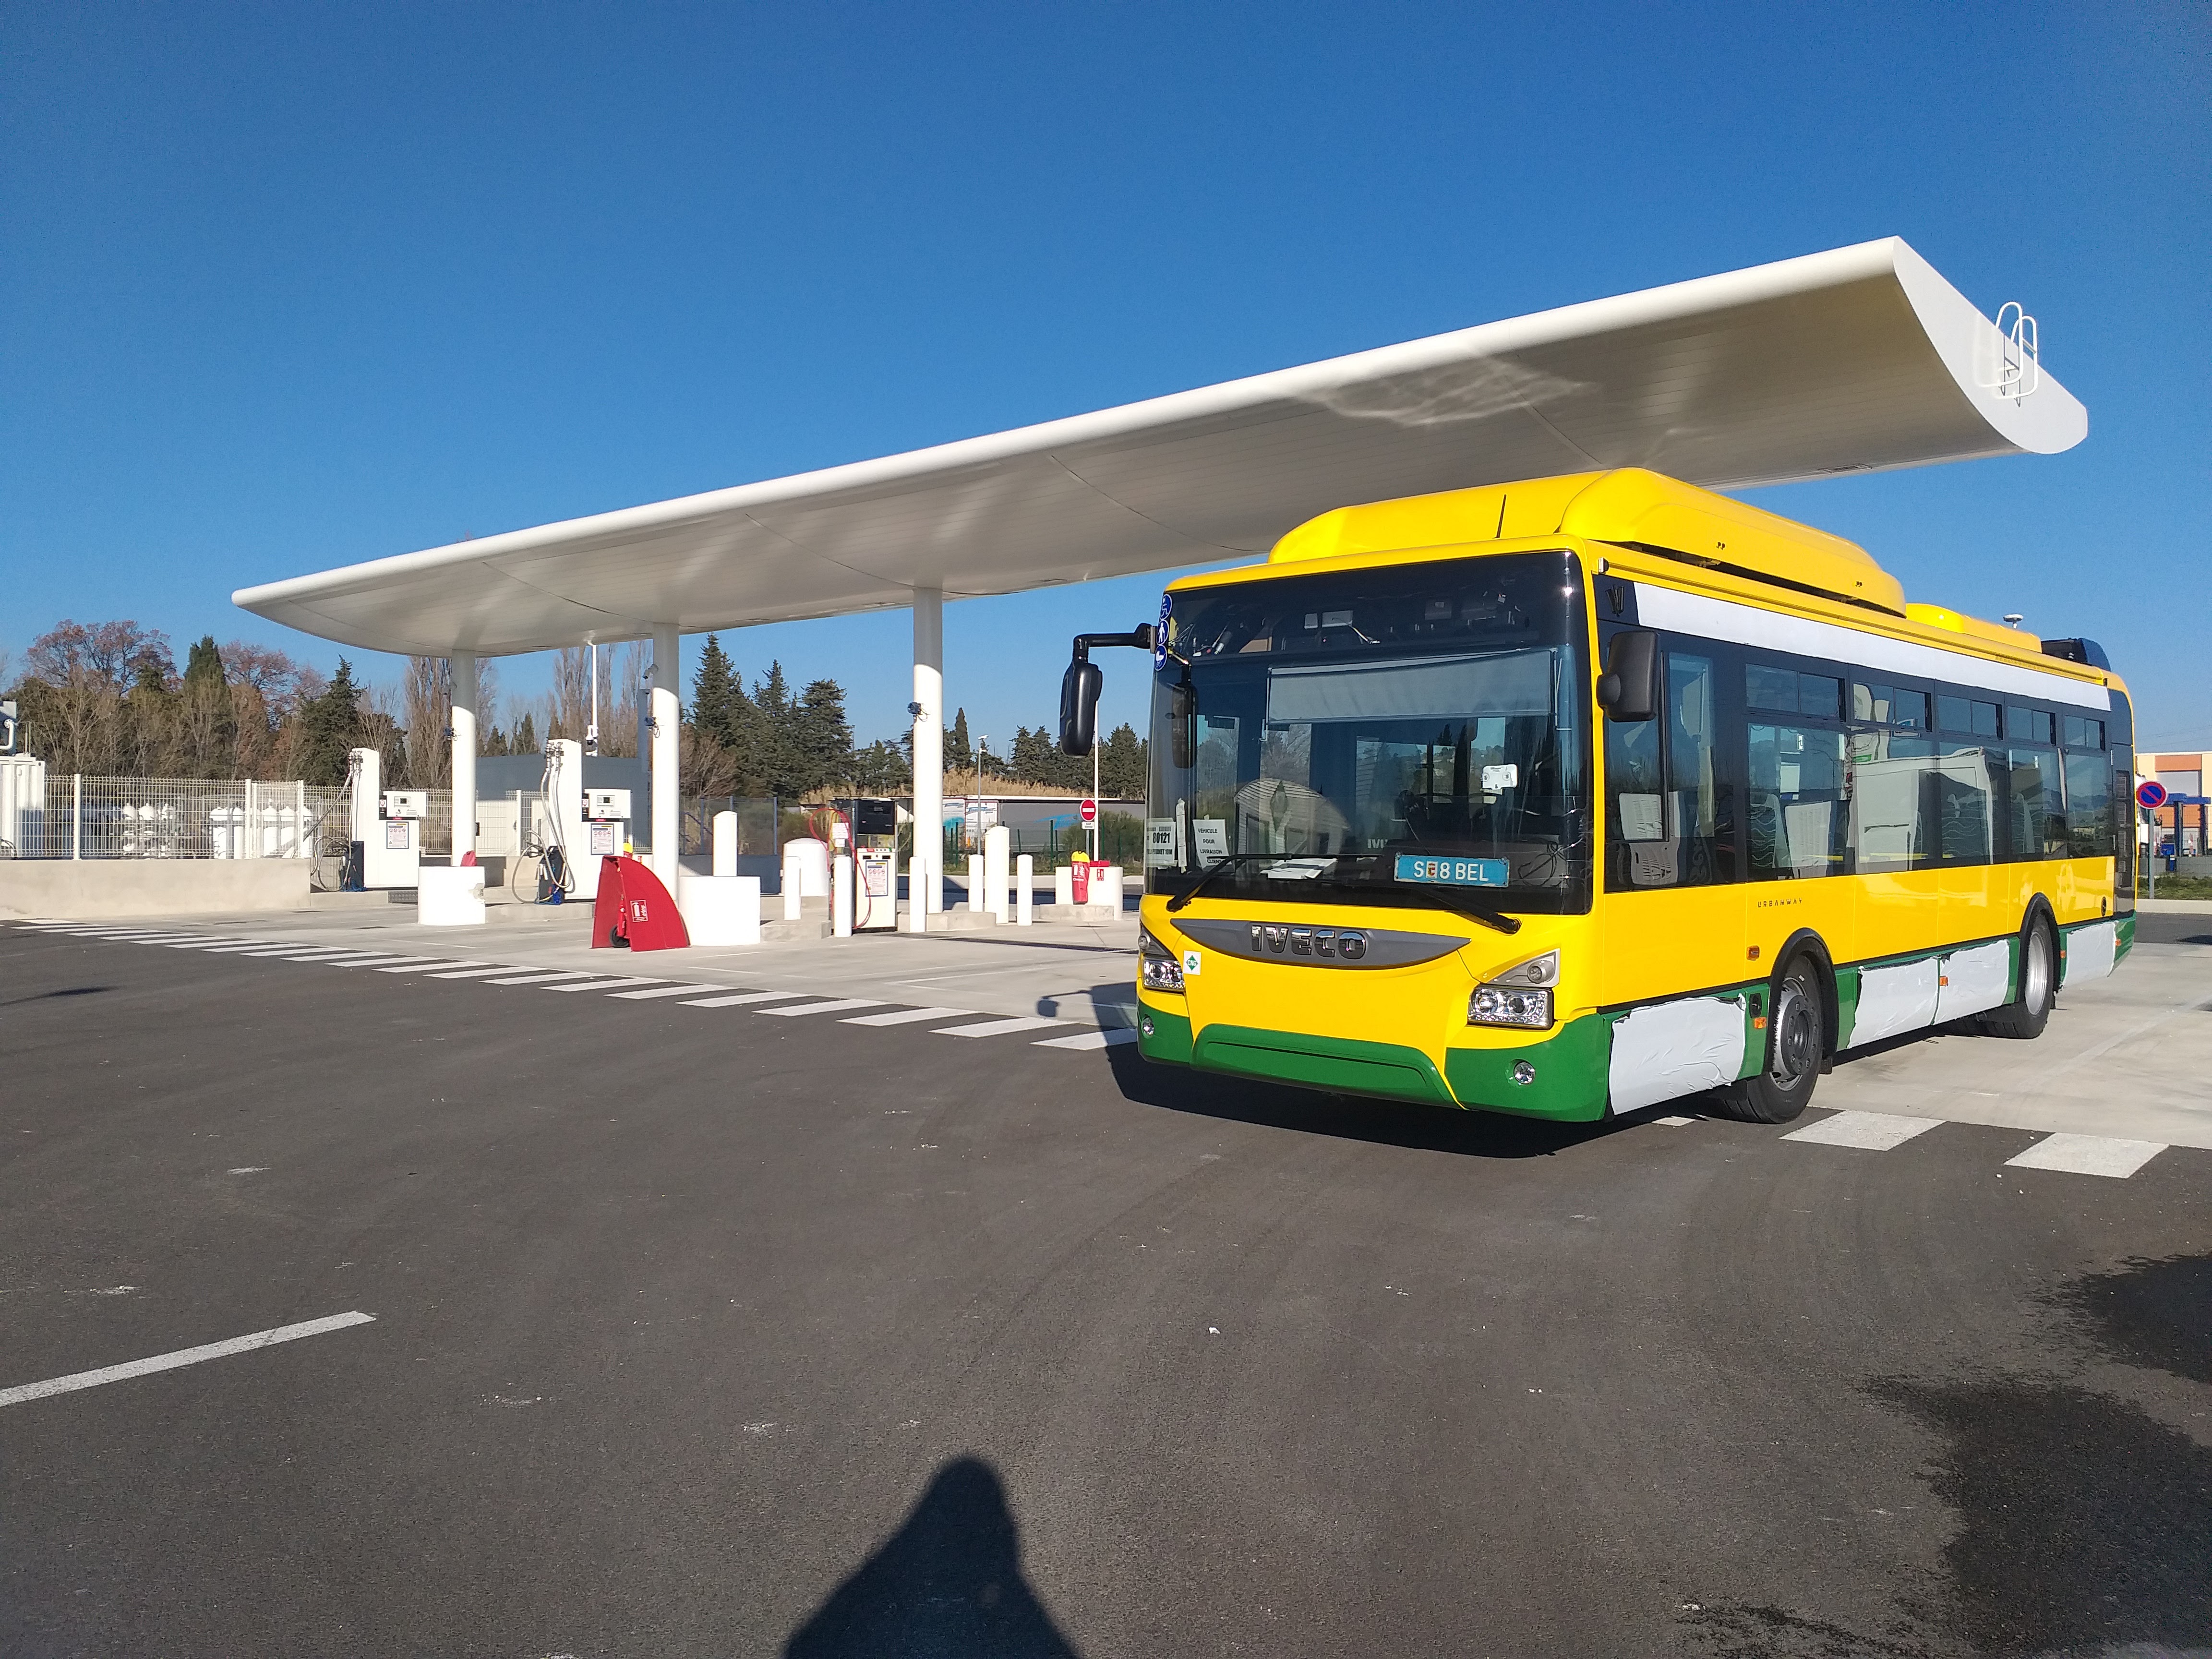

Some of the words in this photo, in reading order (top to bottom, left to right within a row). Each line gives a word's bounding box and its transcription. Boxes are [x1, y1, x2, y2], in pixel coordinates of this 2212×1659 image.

[1153, 832, 1170, 843] 80121
[1455, 863, 1489, 881] BEL
[1251, 925, 1367, 960] IVECO
